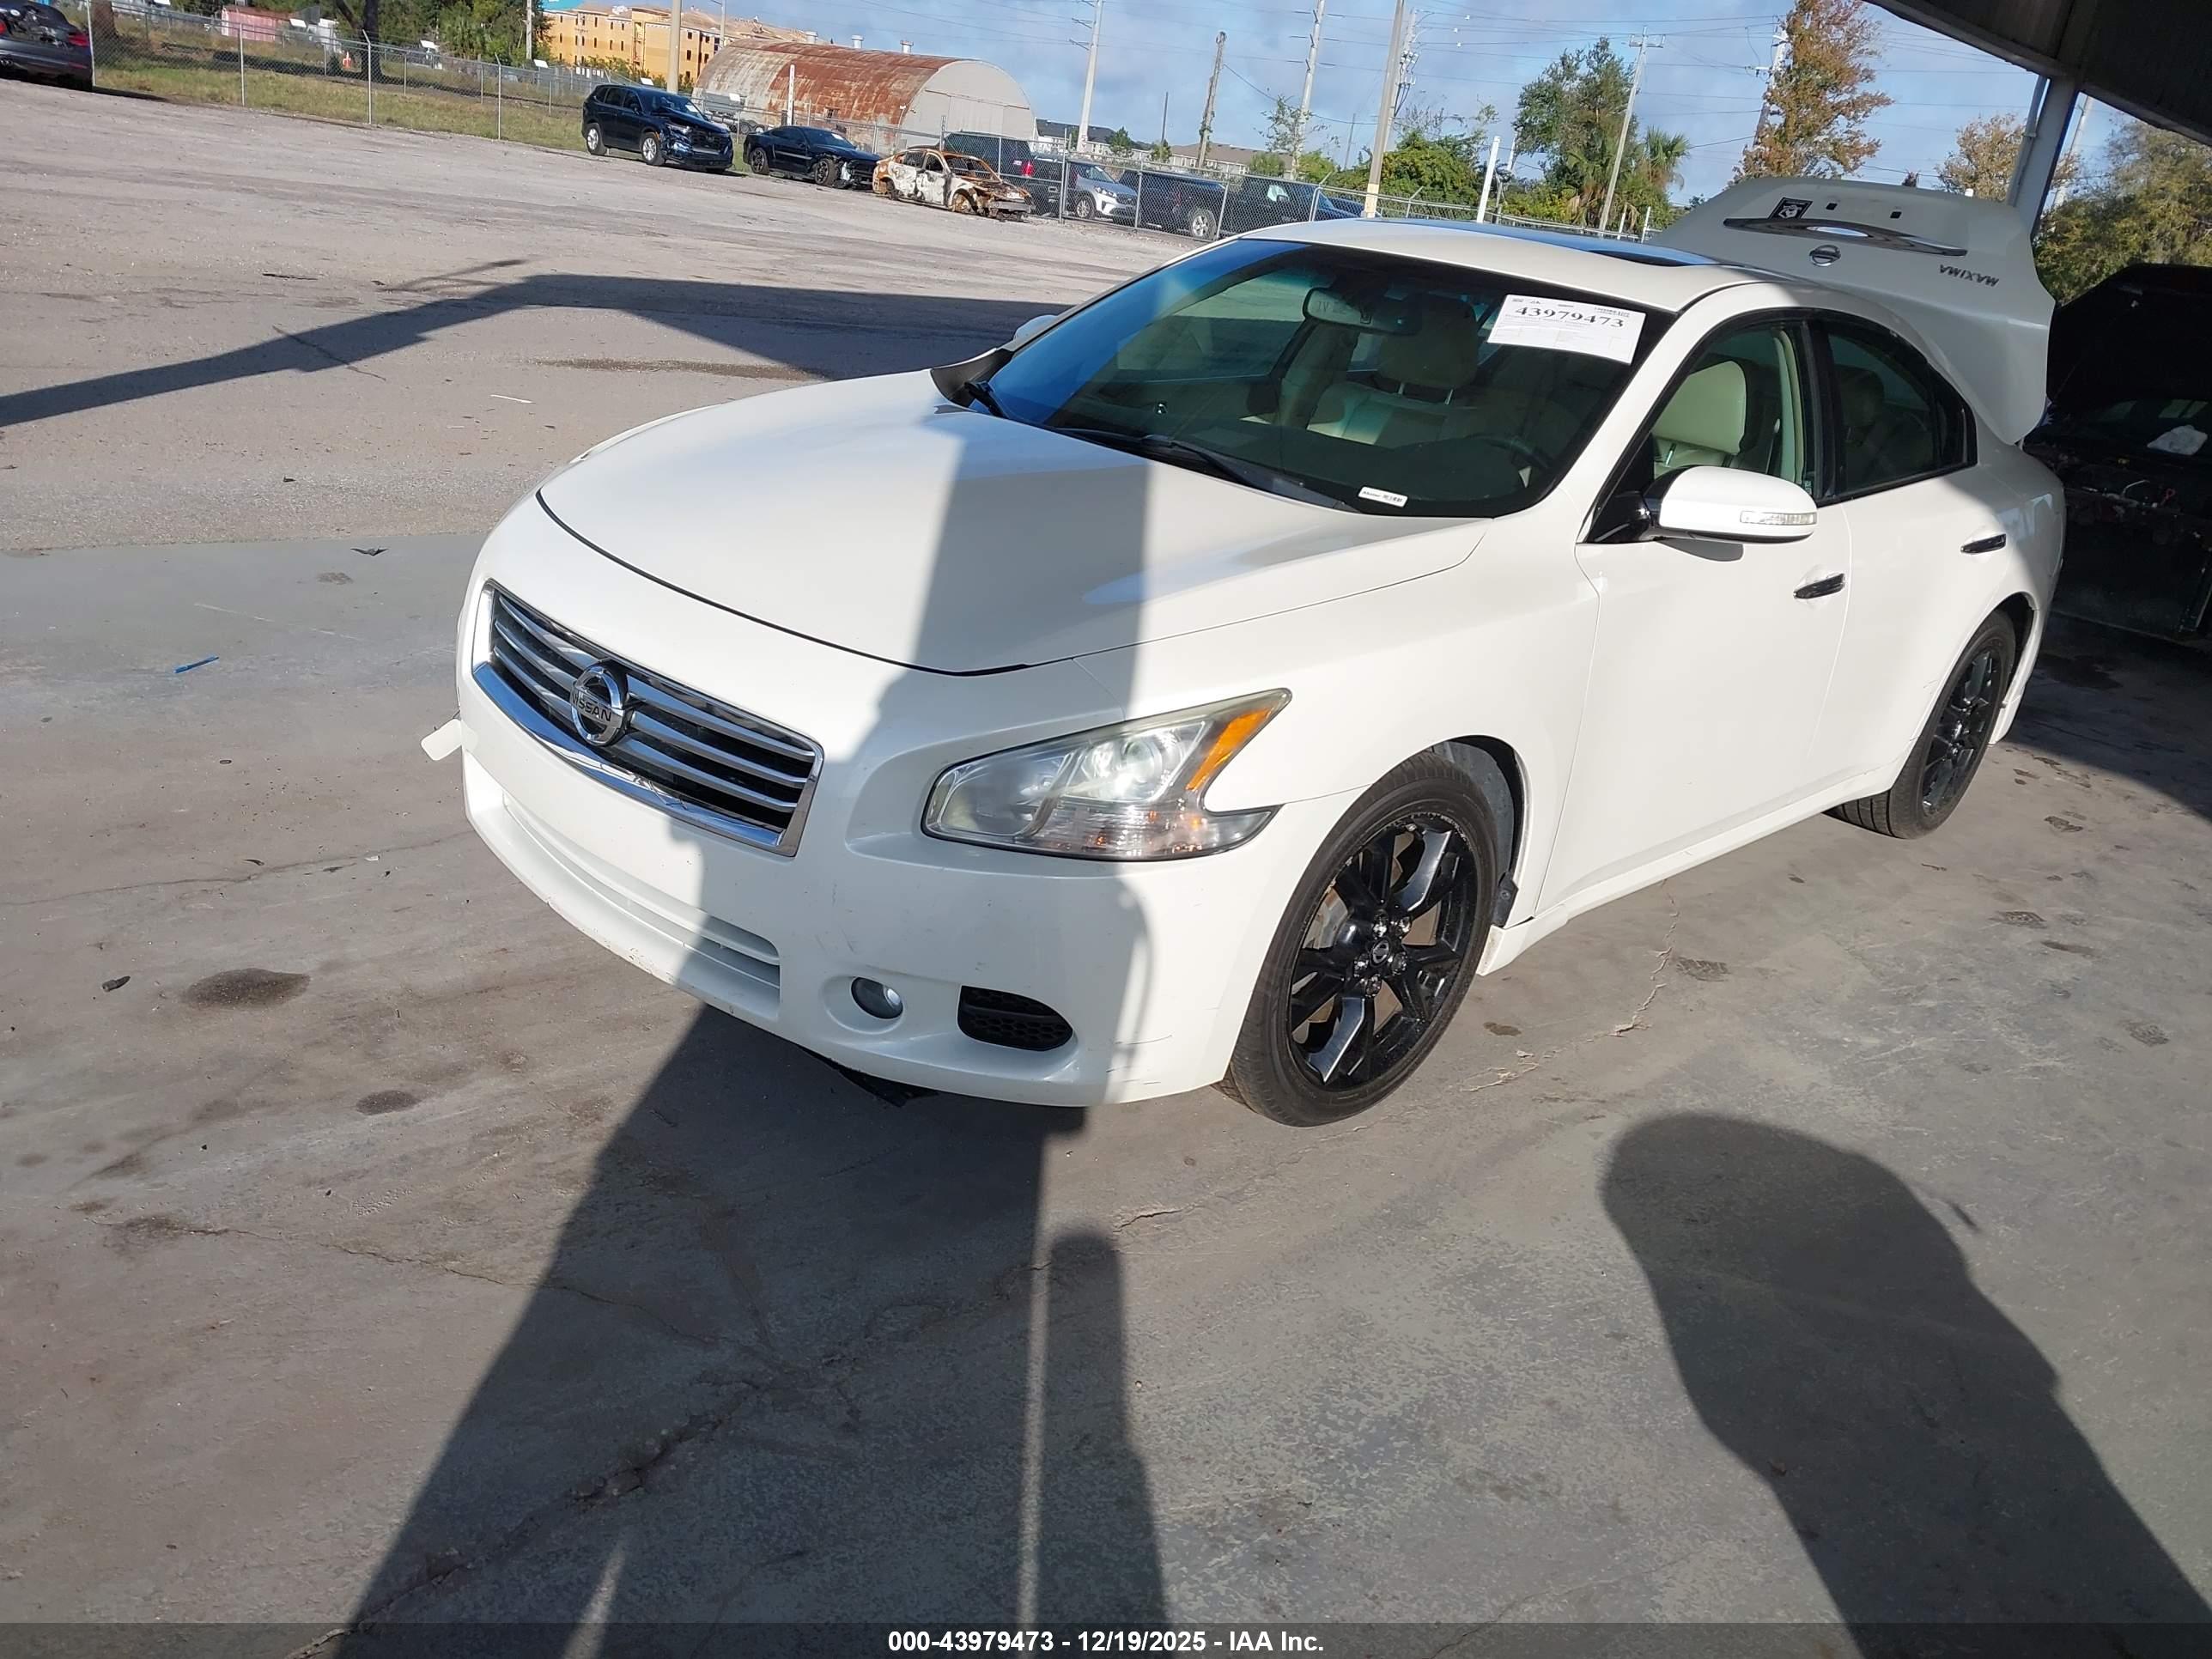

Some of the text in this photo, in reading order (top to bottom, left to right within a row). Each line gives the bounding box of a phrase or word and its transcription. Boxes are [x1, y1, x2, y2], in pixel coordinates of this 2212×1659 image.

[1940, 264, 1999, 287] MAXIMA
[1516, 307, 1624, 328] 43979473
[572, 690, 611, 722] NISSAN
